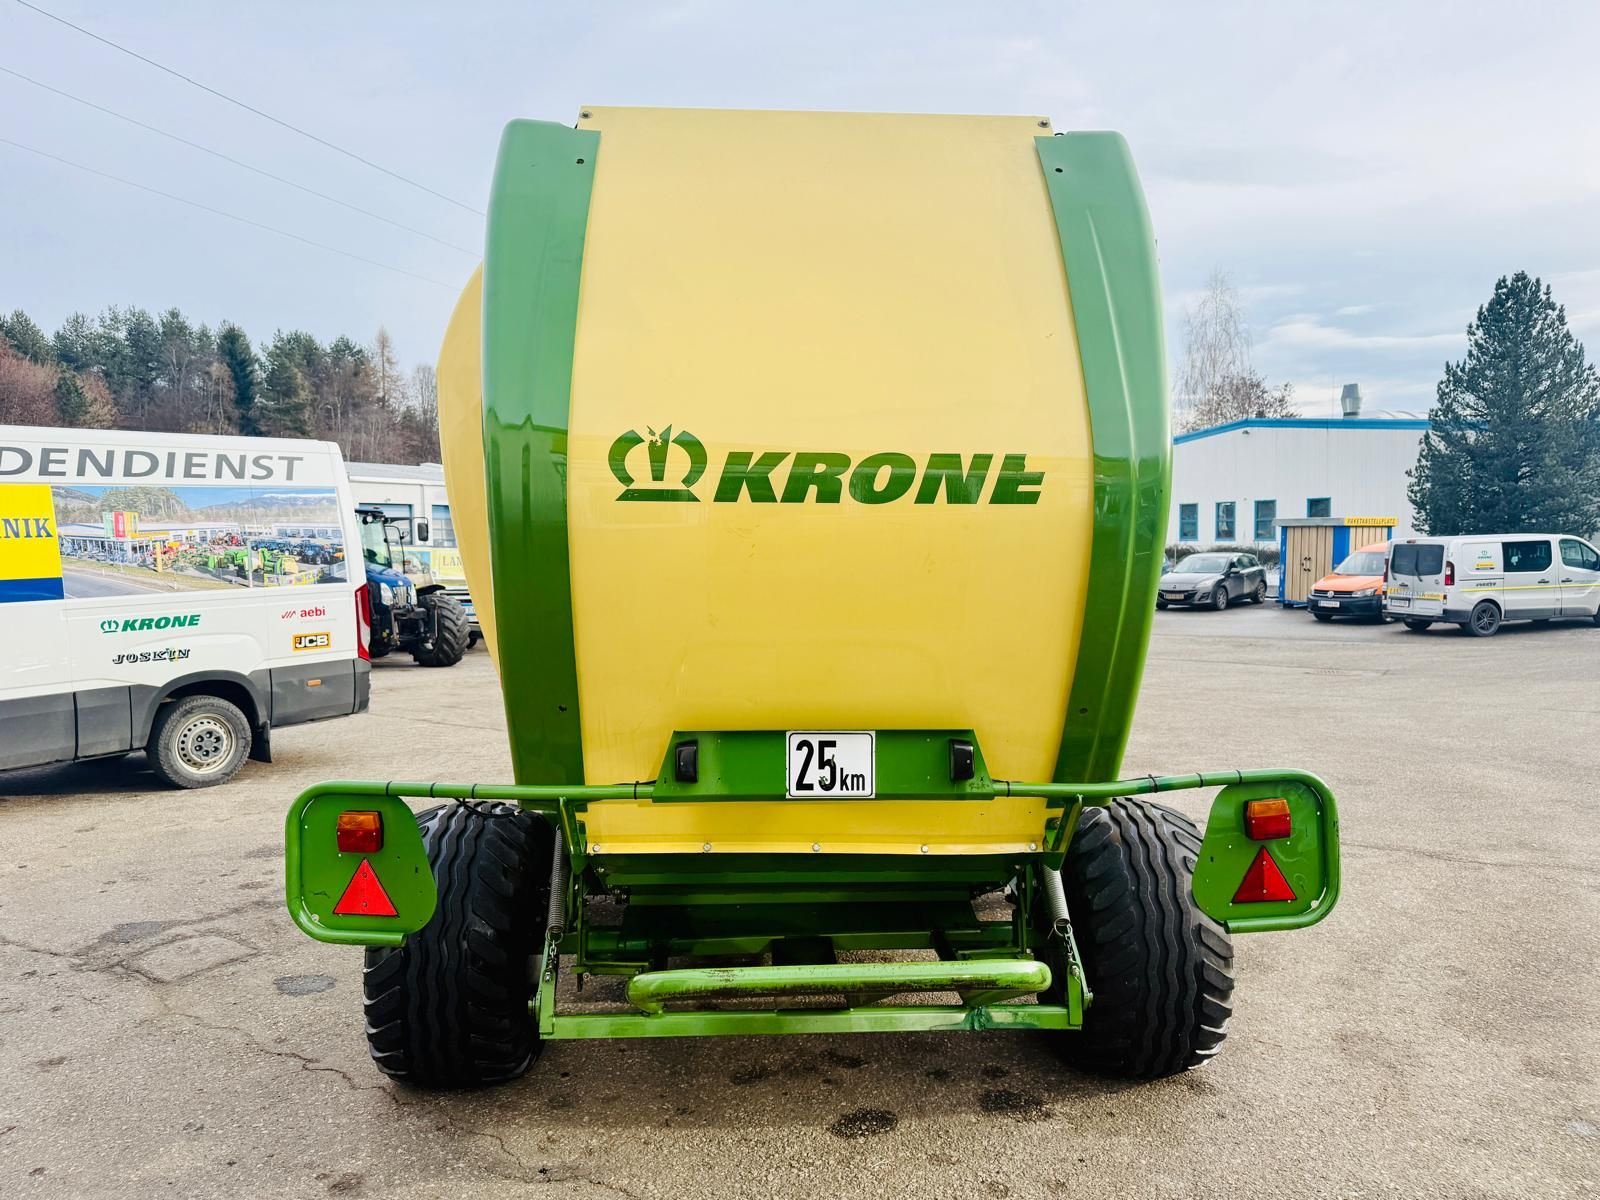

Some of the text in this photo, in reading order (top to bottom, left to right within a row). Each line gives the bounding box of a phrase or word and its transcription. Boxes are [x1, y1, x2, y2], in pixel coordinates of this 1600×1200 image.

[0, 446, 304, 481] DENDIENST
[713, 452, 1046, 505] KRONE
[0, 518, 53, 539] NIK
[300, 605, 326, 618] aebi
[121, 614, 201, 632] KRONE
[295, 634, 329, 648] JCB
[112, 648, 191, 664] JOSKIN
[796, 739, 866, 792] 25 km
